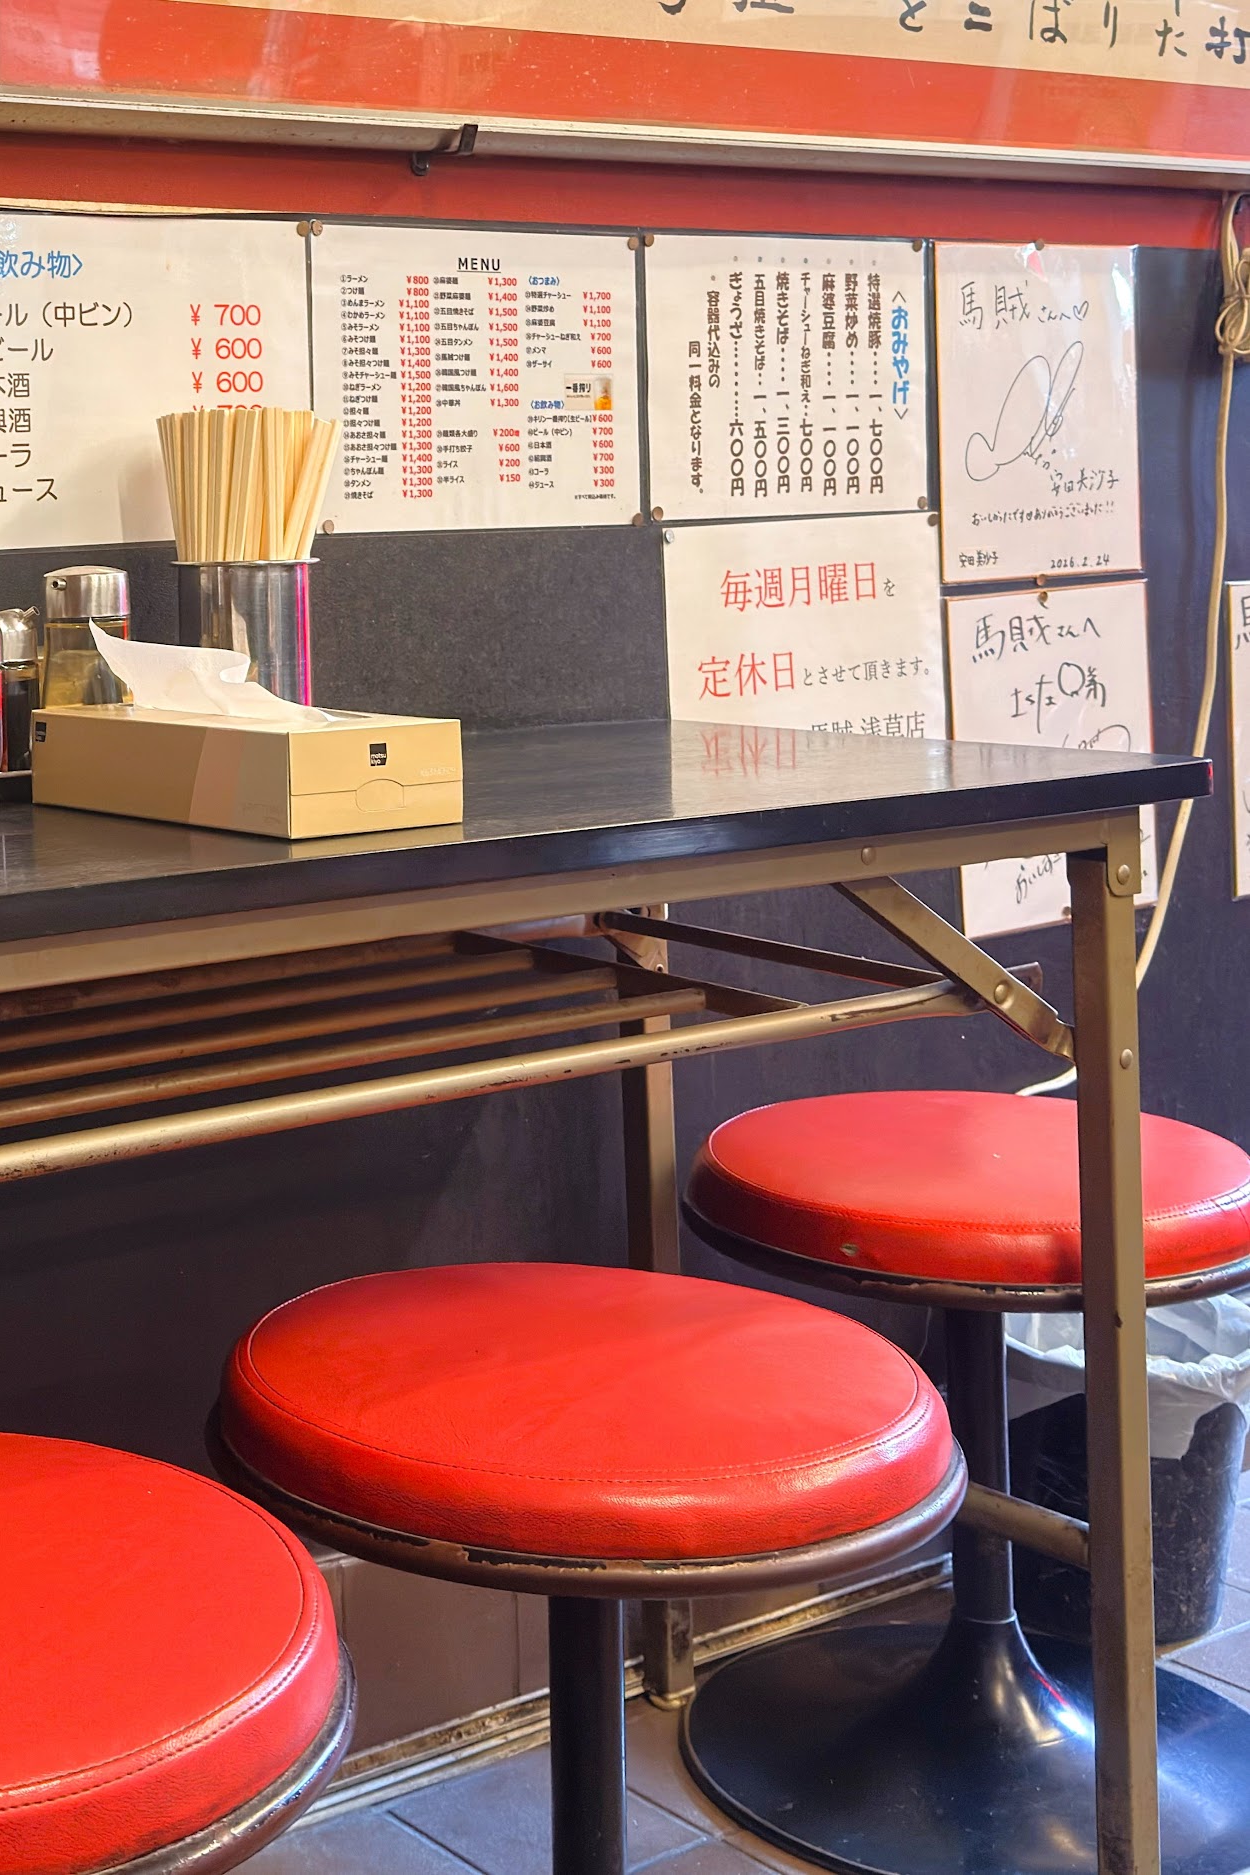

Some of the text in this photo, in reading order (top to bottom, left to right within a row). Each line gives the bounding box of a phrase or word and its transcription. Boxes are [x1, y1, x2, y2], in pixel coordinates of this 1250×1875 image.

[458, 257, 500, 271] MENU
[720, 562, 896, 612] 毎週月曜日を
[698, 651, 930, 700] 定休日とさせて頂きます。
